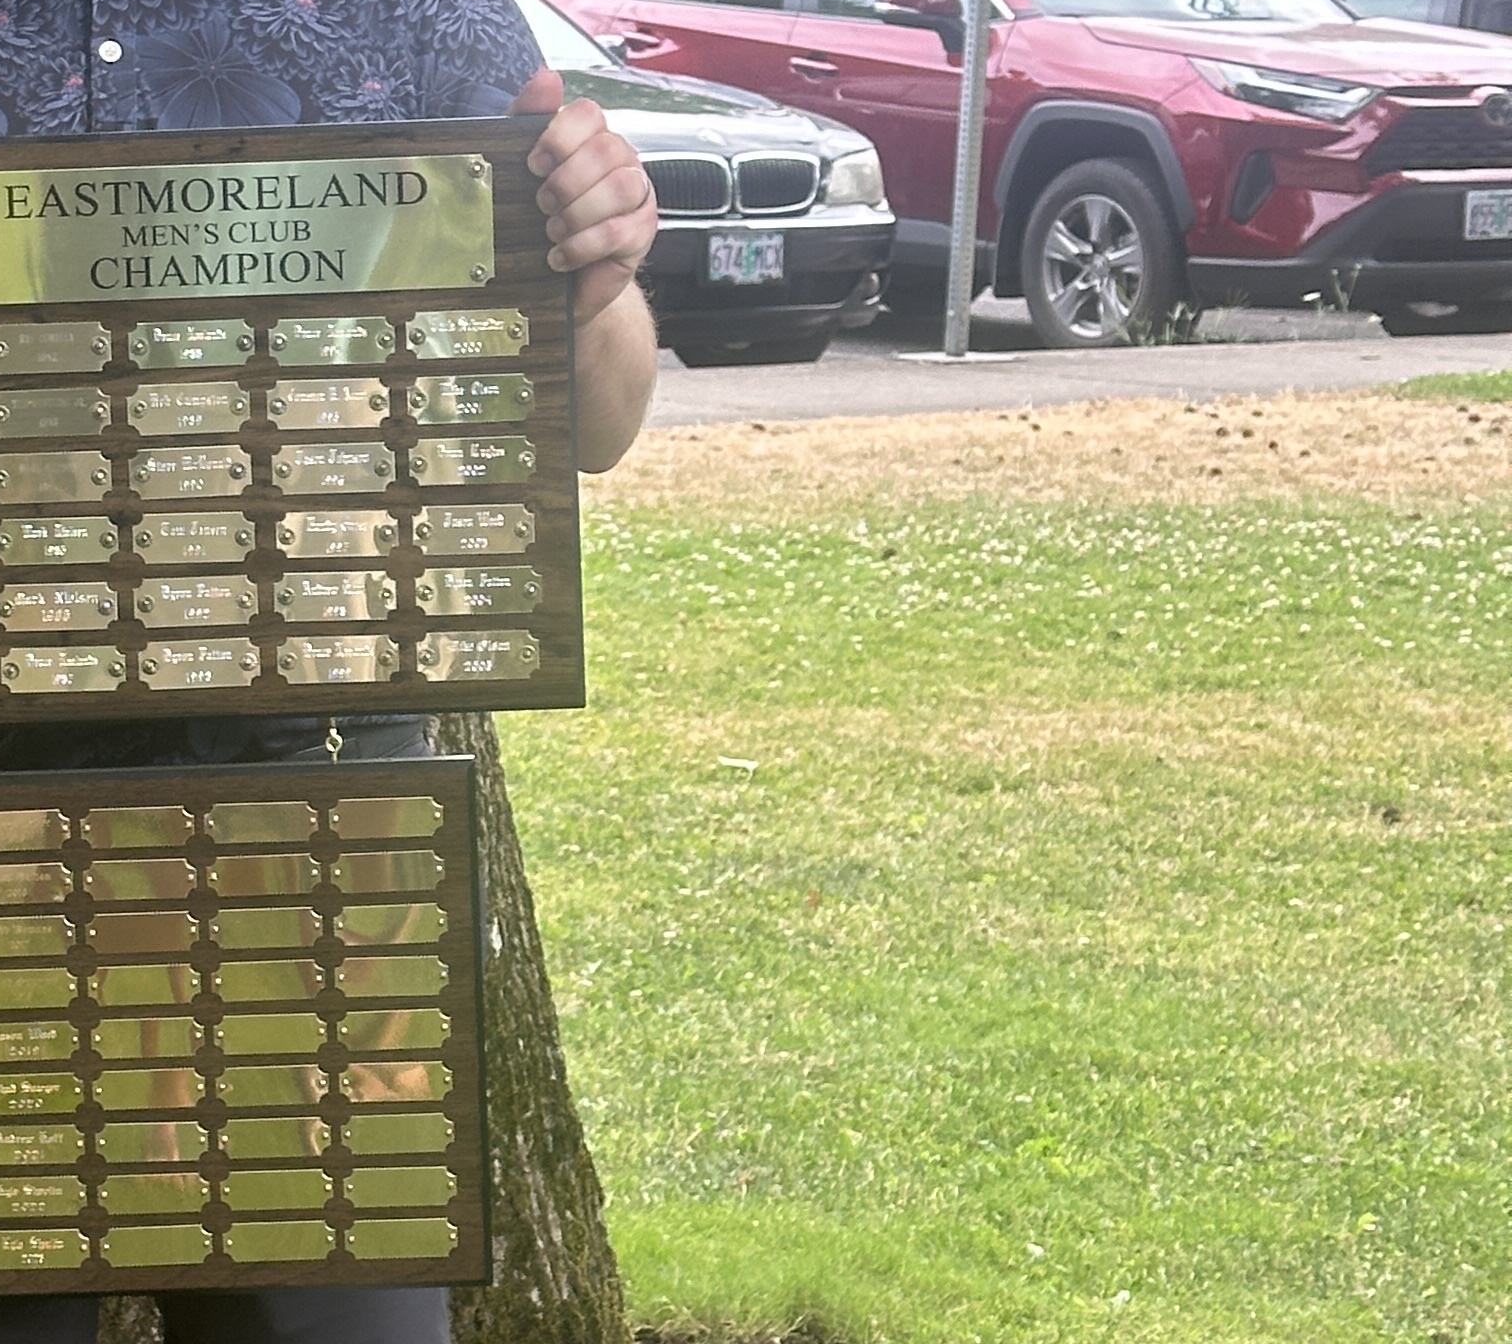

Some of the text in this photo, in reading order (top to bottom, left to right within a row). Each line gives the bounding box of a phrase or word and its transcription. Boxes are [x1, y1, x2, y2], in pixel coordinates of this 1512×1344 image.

[4, 171, 429, 219] EASTMORELAND
[122, 220, 312, 248] MEN'S CLUB
[90, 248, 346, 290] CHAMPION
